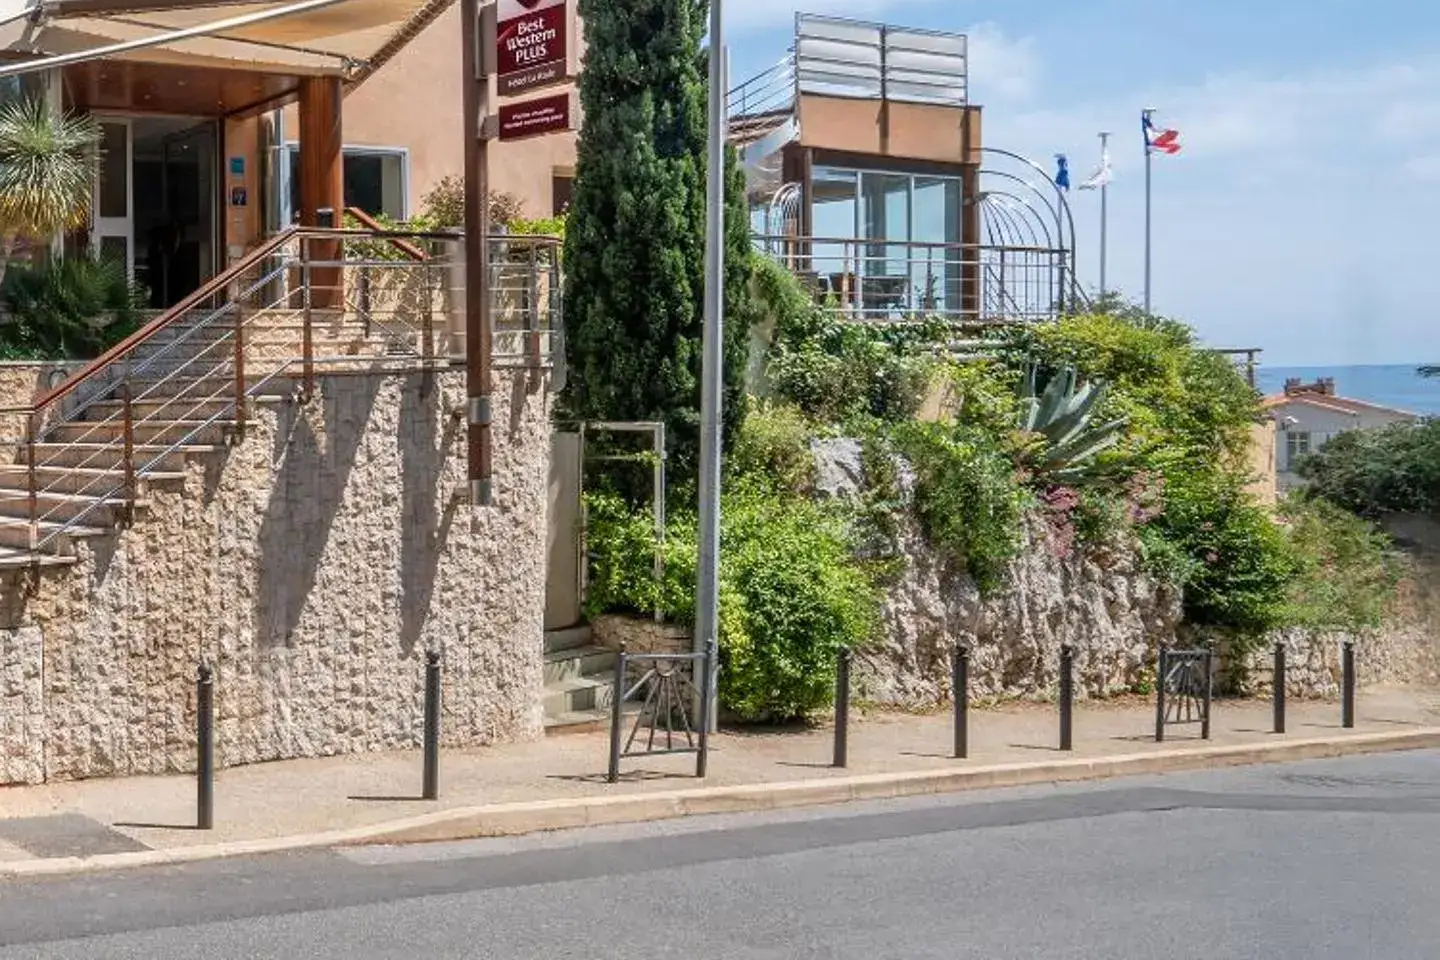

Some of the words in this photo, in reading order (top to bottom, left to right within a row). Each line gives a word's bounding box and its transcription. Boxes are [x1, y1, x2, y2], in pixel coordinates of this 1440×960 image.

[517, 17, 544, 35] Best
[506, 28, 556, 51] Western
[515, 43, 547, 62] PLUS
